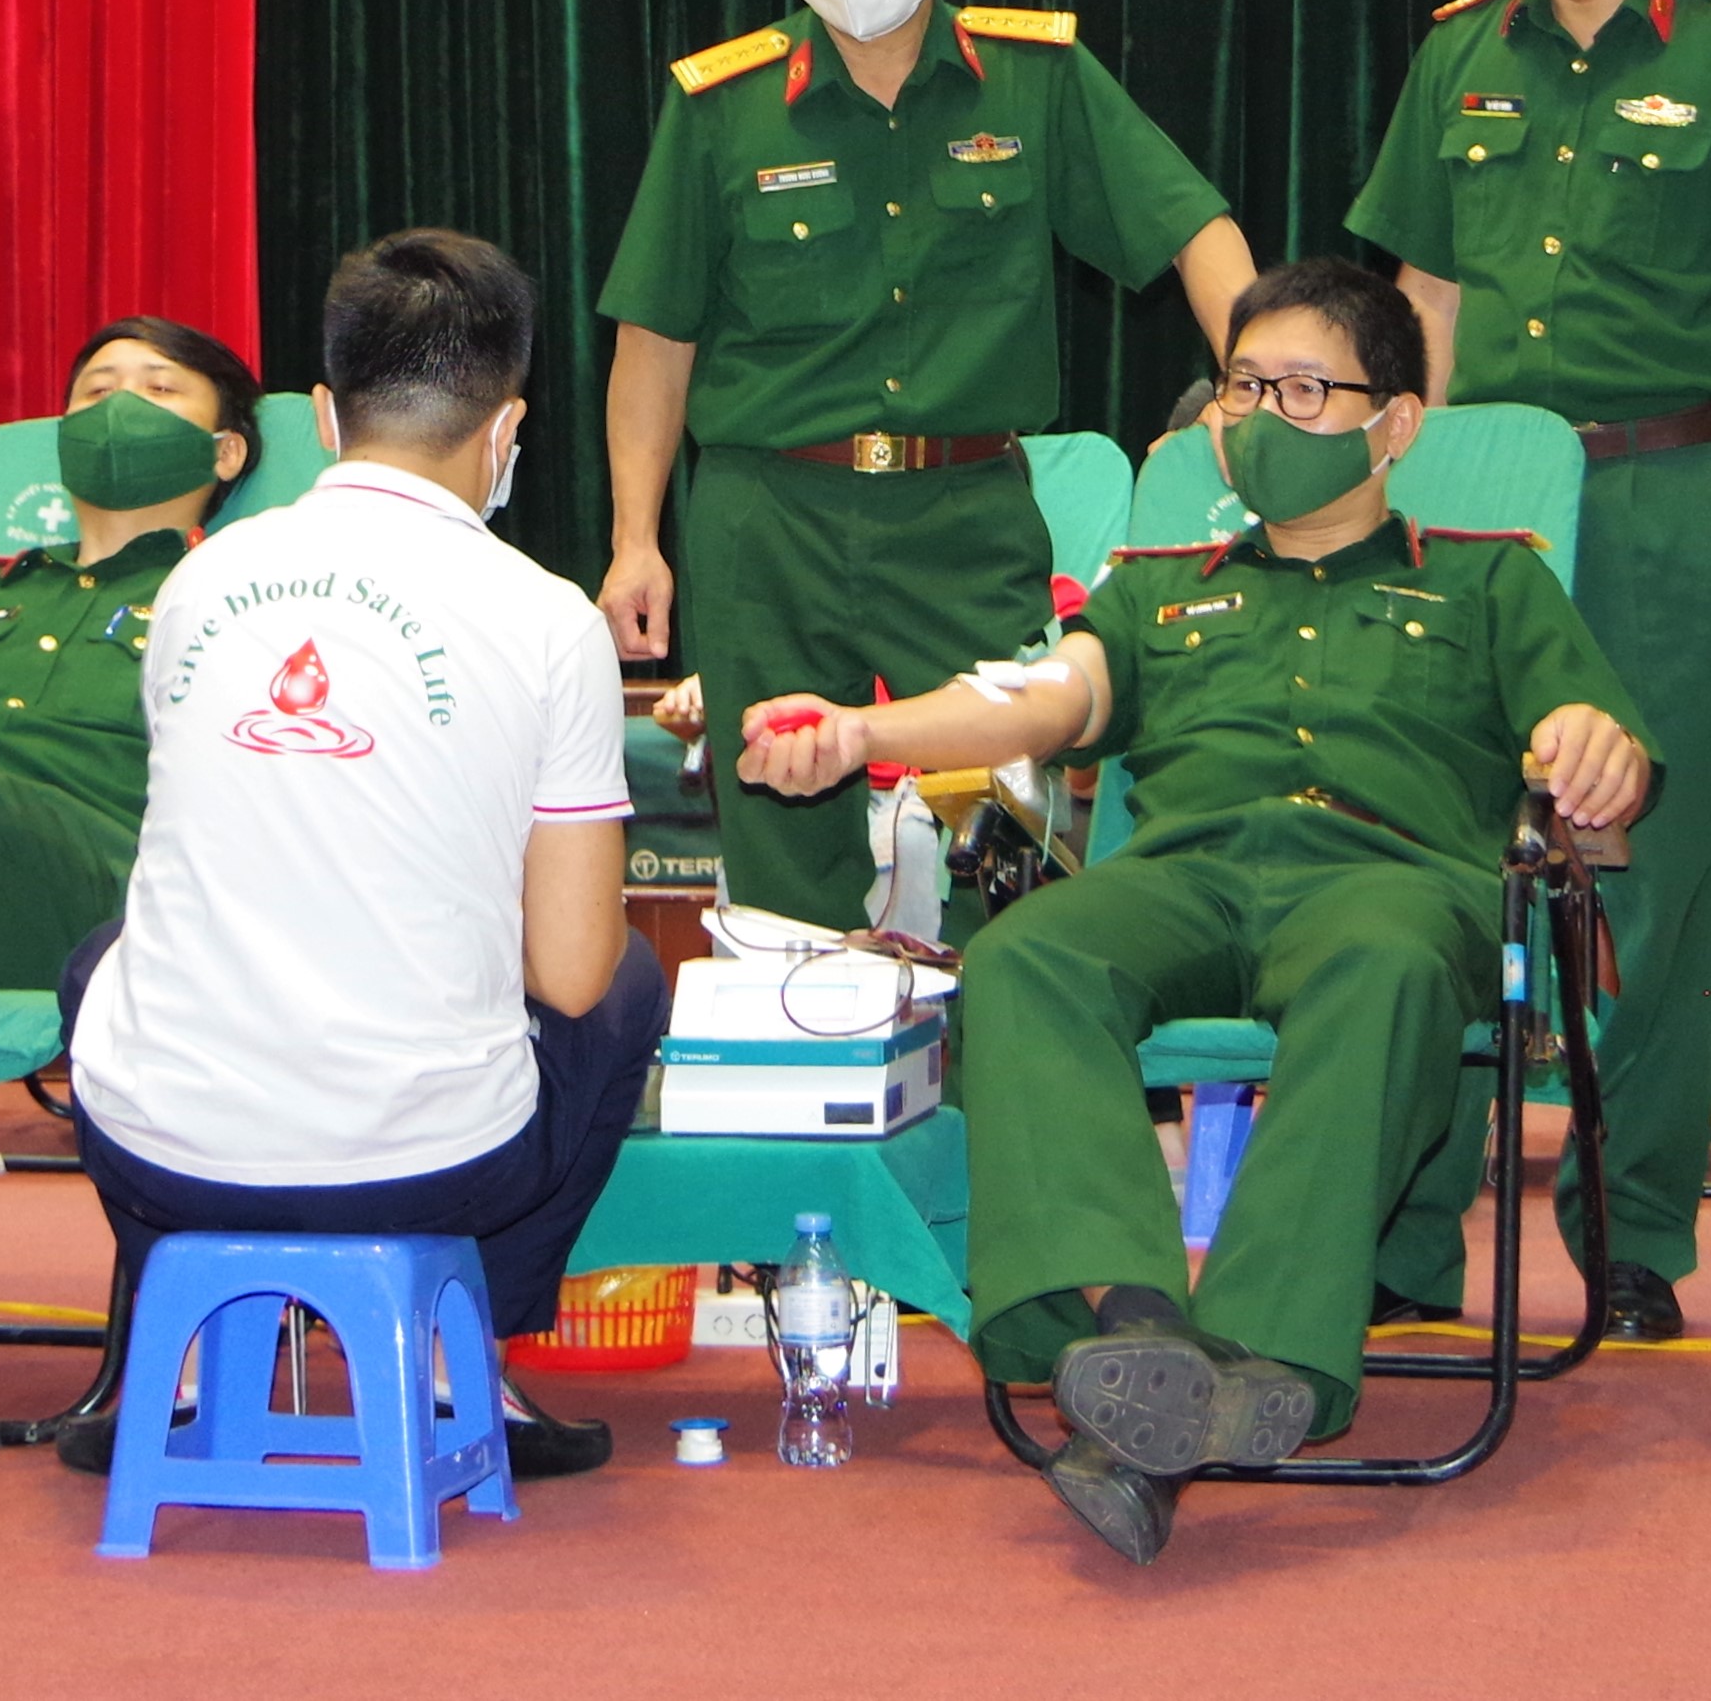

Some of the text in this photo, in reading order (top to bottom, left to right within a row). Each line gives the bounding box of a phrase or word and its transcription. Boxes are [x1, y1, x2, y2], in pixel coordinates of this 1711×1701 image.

[169, 571, 457, 727] Give blood Save Life
